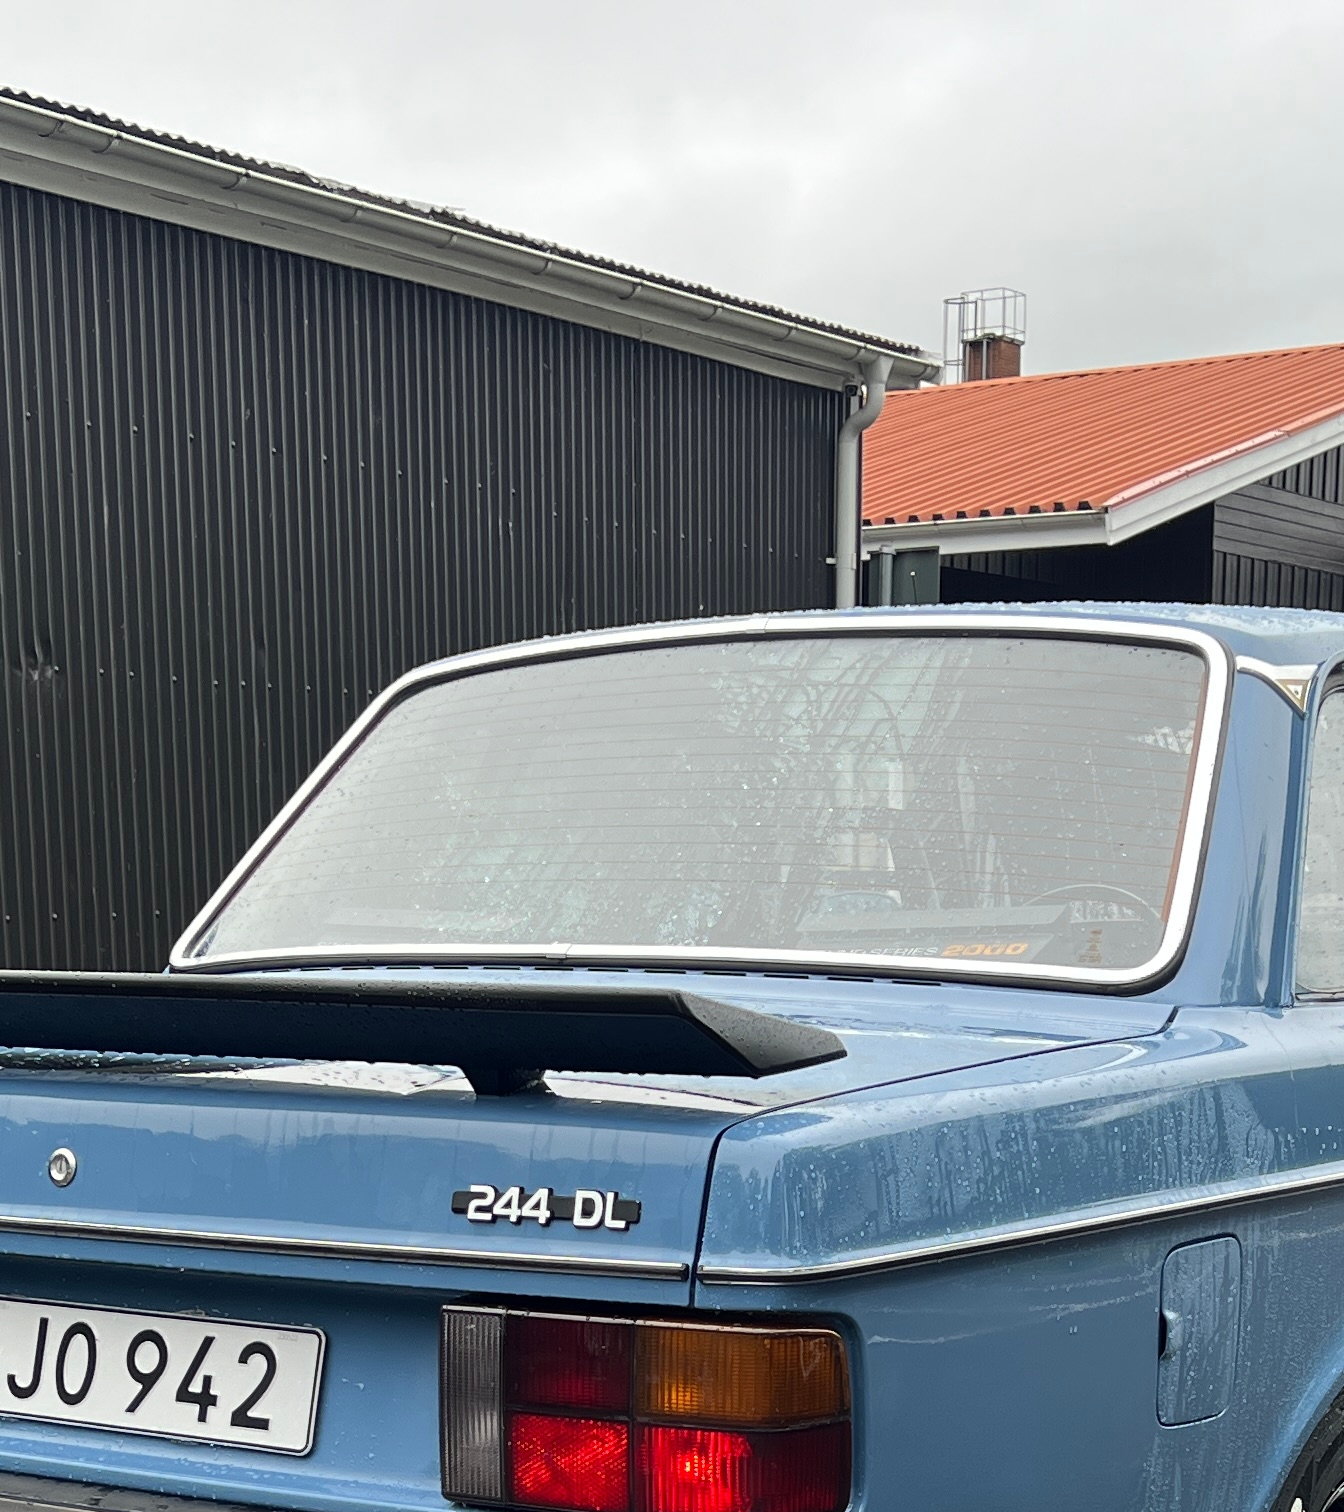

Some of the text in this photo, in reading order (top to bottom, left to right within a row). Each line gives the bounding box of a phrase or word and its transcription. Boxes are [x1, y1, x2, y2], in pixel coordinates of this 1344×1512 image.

[940, 943, 1029, 958] 2000
[467, 1184, 627, 1229] 244 DL
[123, 1328, 278, 1431] 942
